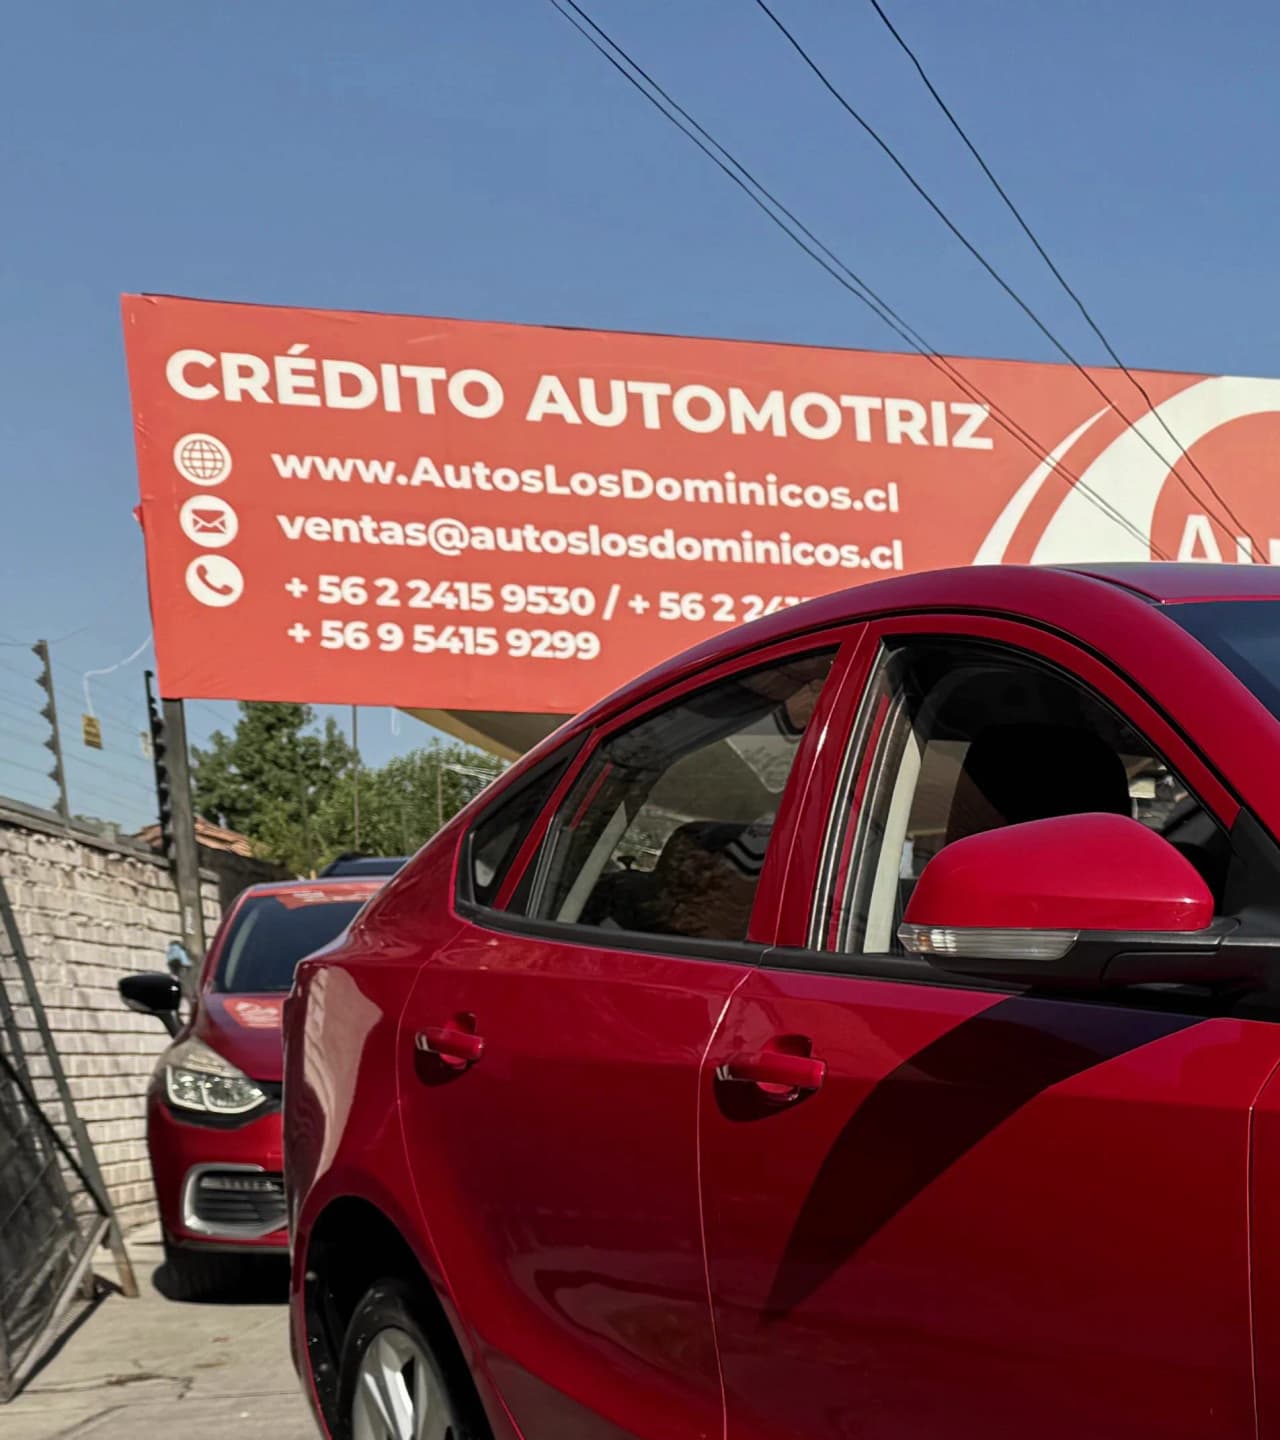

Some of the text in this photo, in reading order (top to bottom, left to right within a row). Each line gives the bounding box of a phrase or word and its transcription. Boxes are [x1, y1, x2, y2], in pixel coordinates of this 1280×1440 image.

[166, 344, 995, 450] CRÉDITO AUTOMOTRIZ
[271, 453, 900, 513] www.AutosLosDominicos.cl
[277, 513, 904, 570] ventas@autoslosdominicos.cl
[318, 574, 368, 605] 56
[373, 577, 401, 607] 2
[405, 579, 494, 612] 2415
[500, 583, 595, 616] 9530
[659, 591, 706, 622] 56
[711, 593, 736, 622] 2
[320, 619, 370, 650] 56
[376, 622, 404, 652] 9
[412, 624, 499, 656] 5415
[505, 627, 601, 660] 9299
